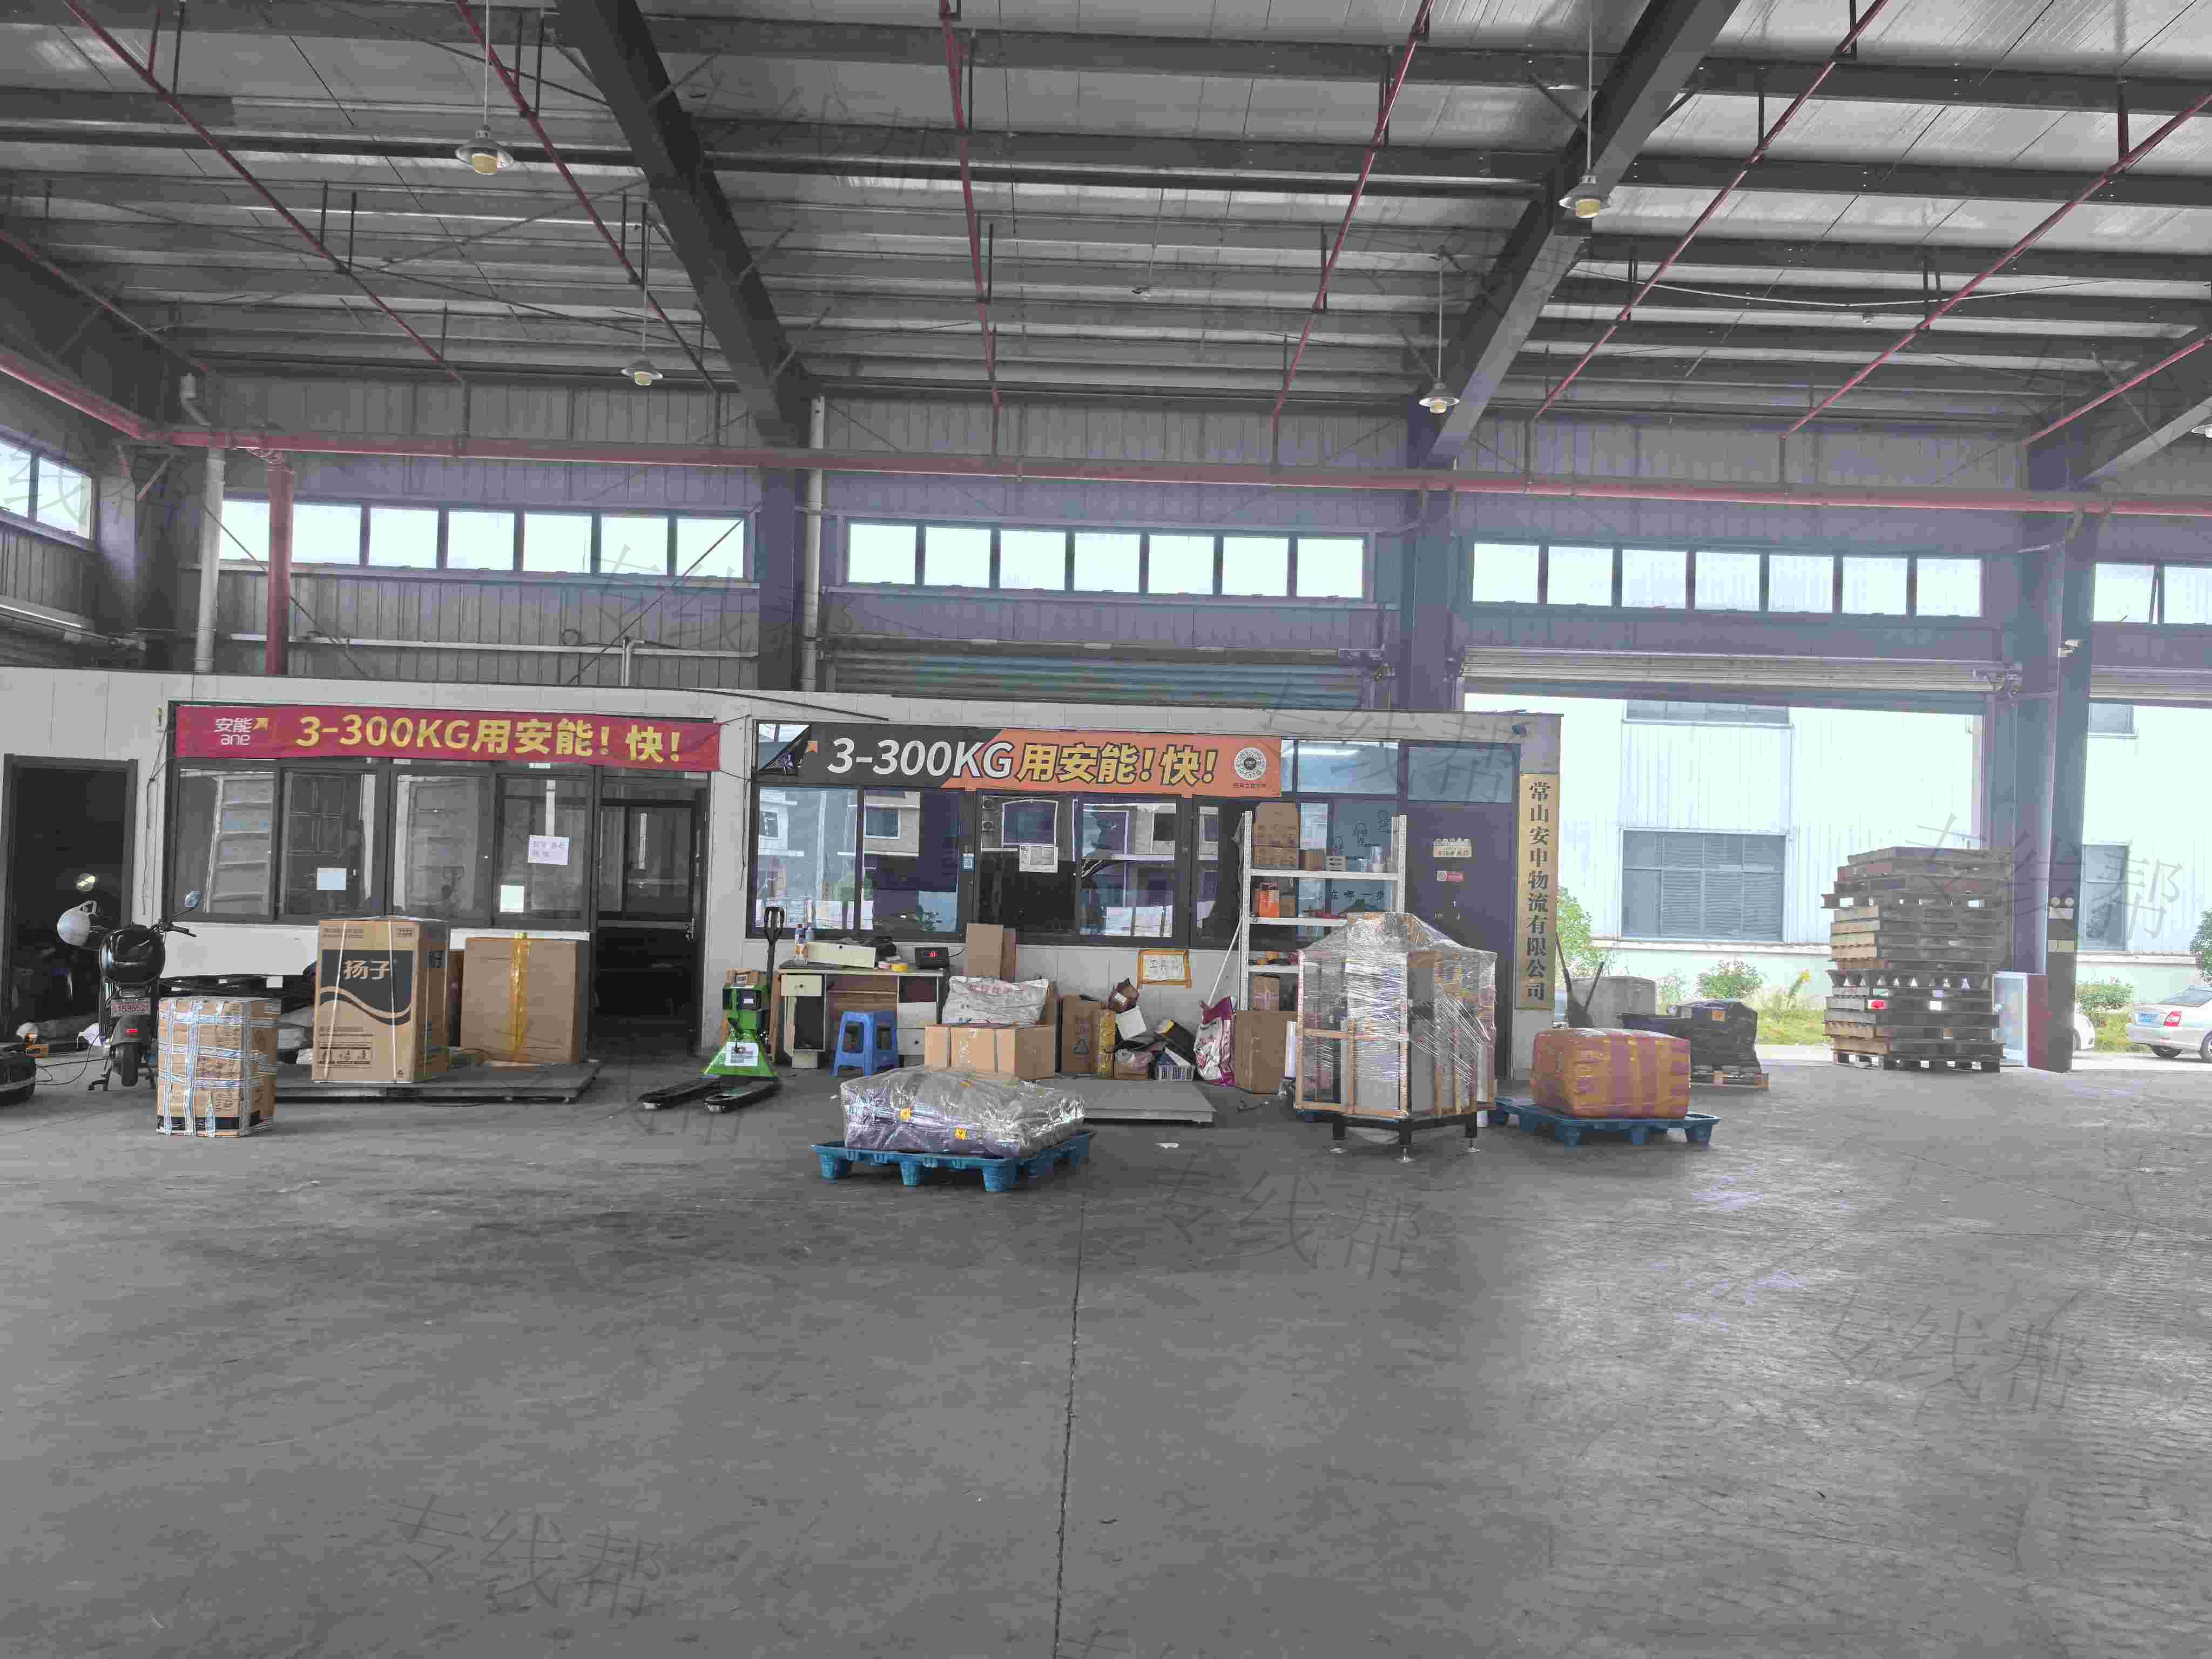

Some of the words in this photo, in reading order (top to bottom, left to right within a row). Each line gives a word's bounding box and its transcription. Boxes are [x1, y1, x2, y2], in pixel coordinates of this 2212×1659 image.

[214, 717, 253, 733] 安能
[220, 733, 251, 746] ane
[1526, 781, 1551, 1001] 常山安申物流有限公司
[343, 959, 391, 980] 扬子
